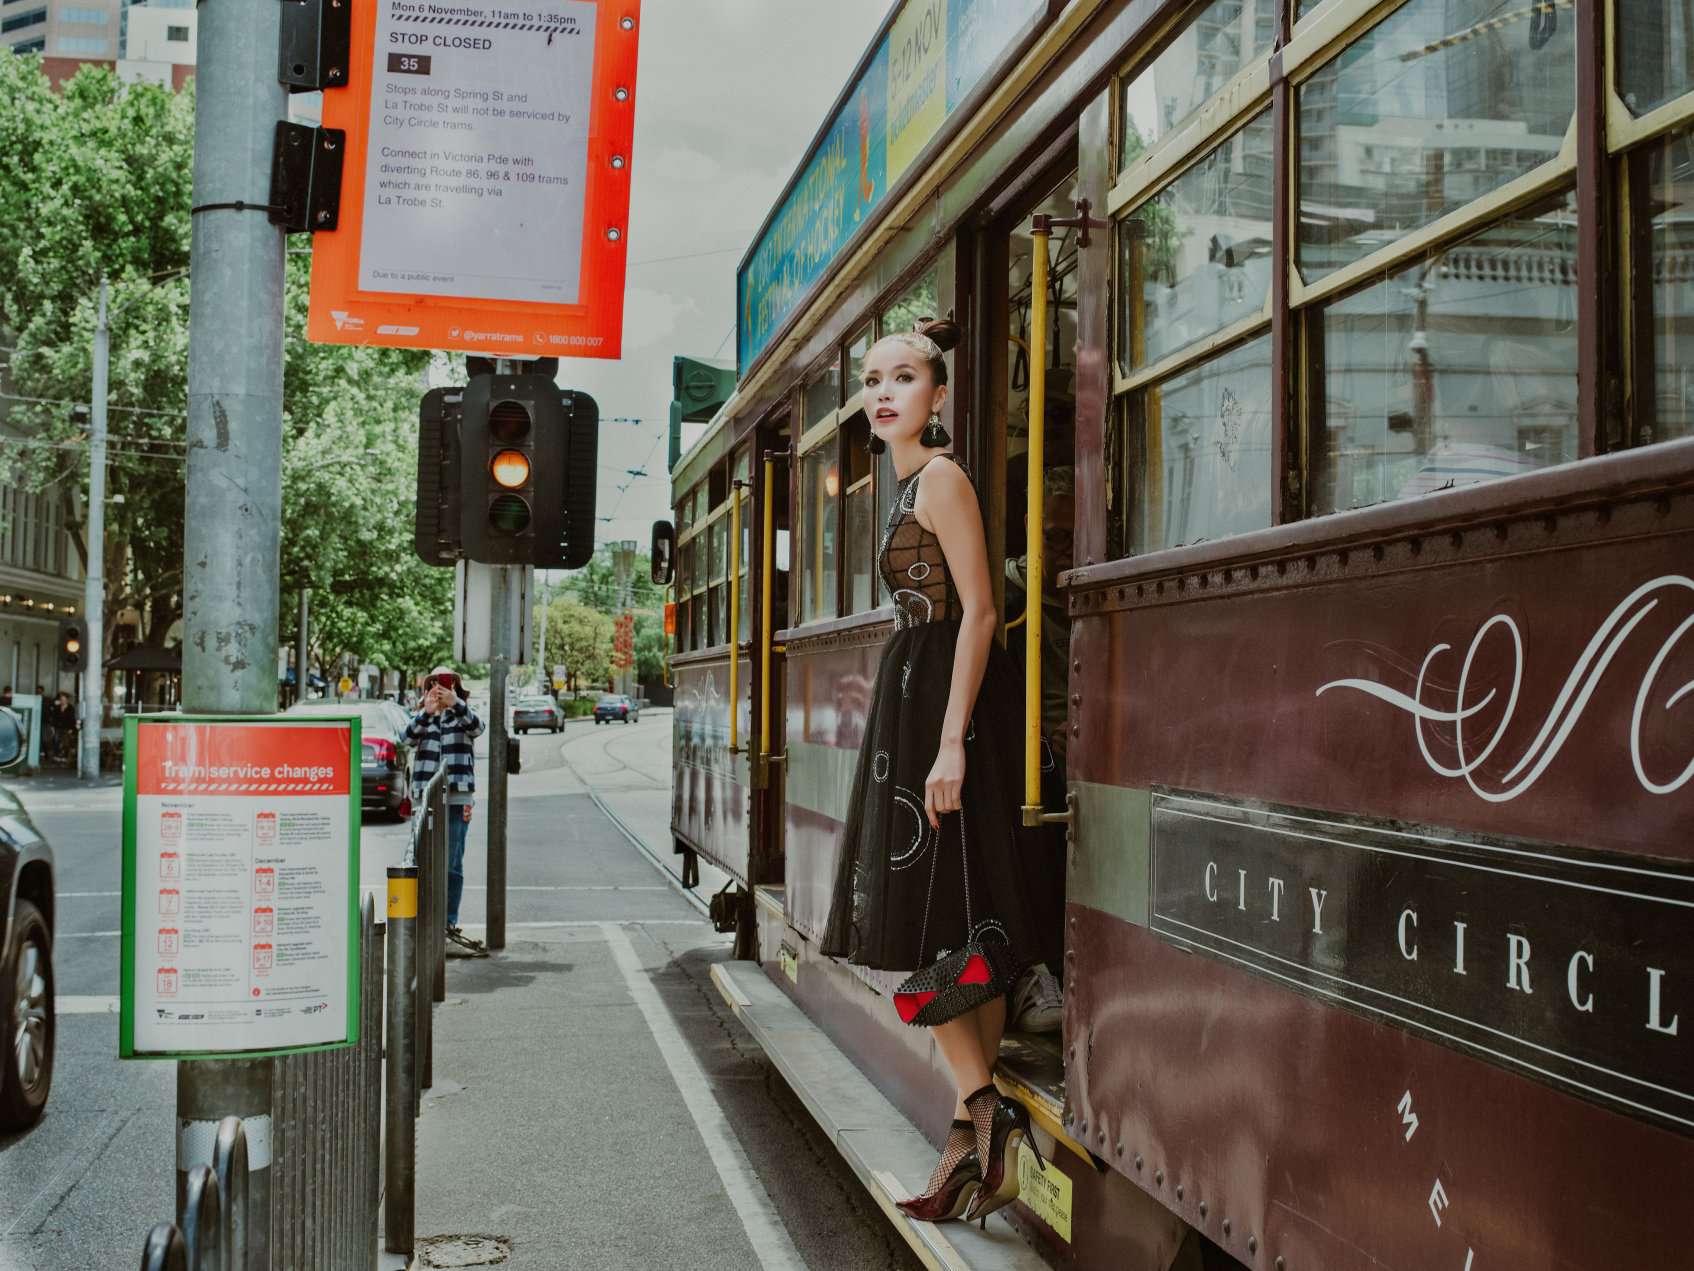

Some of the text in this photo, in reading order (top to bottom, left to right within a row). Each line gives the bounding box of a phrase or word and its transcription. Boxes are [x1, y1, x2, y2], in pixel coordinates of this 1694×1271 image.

[391, 2, 576, 25] Mon 6 November, 11am to 1:35pm
[390, 32, 492, 50] STOP CLOSED
[914, 0, 942, 66] NOV
[400, 57, 418, 71] 35
[386, 83, 528, 103] Stops along Spring St and
[384, 115, 405, 128] City
[407, 116, 439, 128] Circle
[385, 100, 571, 124] La Trobe St will not be serviced by
[381, 147, 534, 167] Connect in Victoria Pde with
[380, 163, 568, 186] diverting Route 86, 96 & 109 trams
[379, 179, 503, 197] which are travelling via
[378, 195, 391, 206] La
[395, 196, 428, 207] Trobe
[372, 270, 388, 279] Due
[390, 272, 397, 280] to
[407, 273, 430, 283] public
[585, 337, 604, 345] 007
[162, 761, 334, 780] Tram service changes
[1204, 861, 1679, 1037] CITY CIRCL
[1047, 1179, 1060, 1201] FIRST
